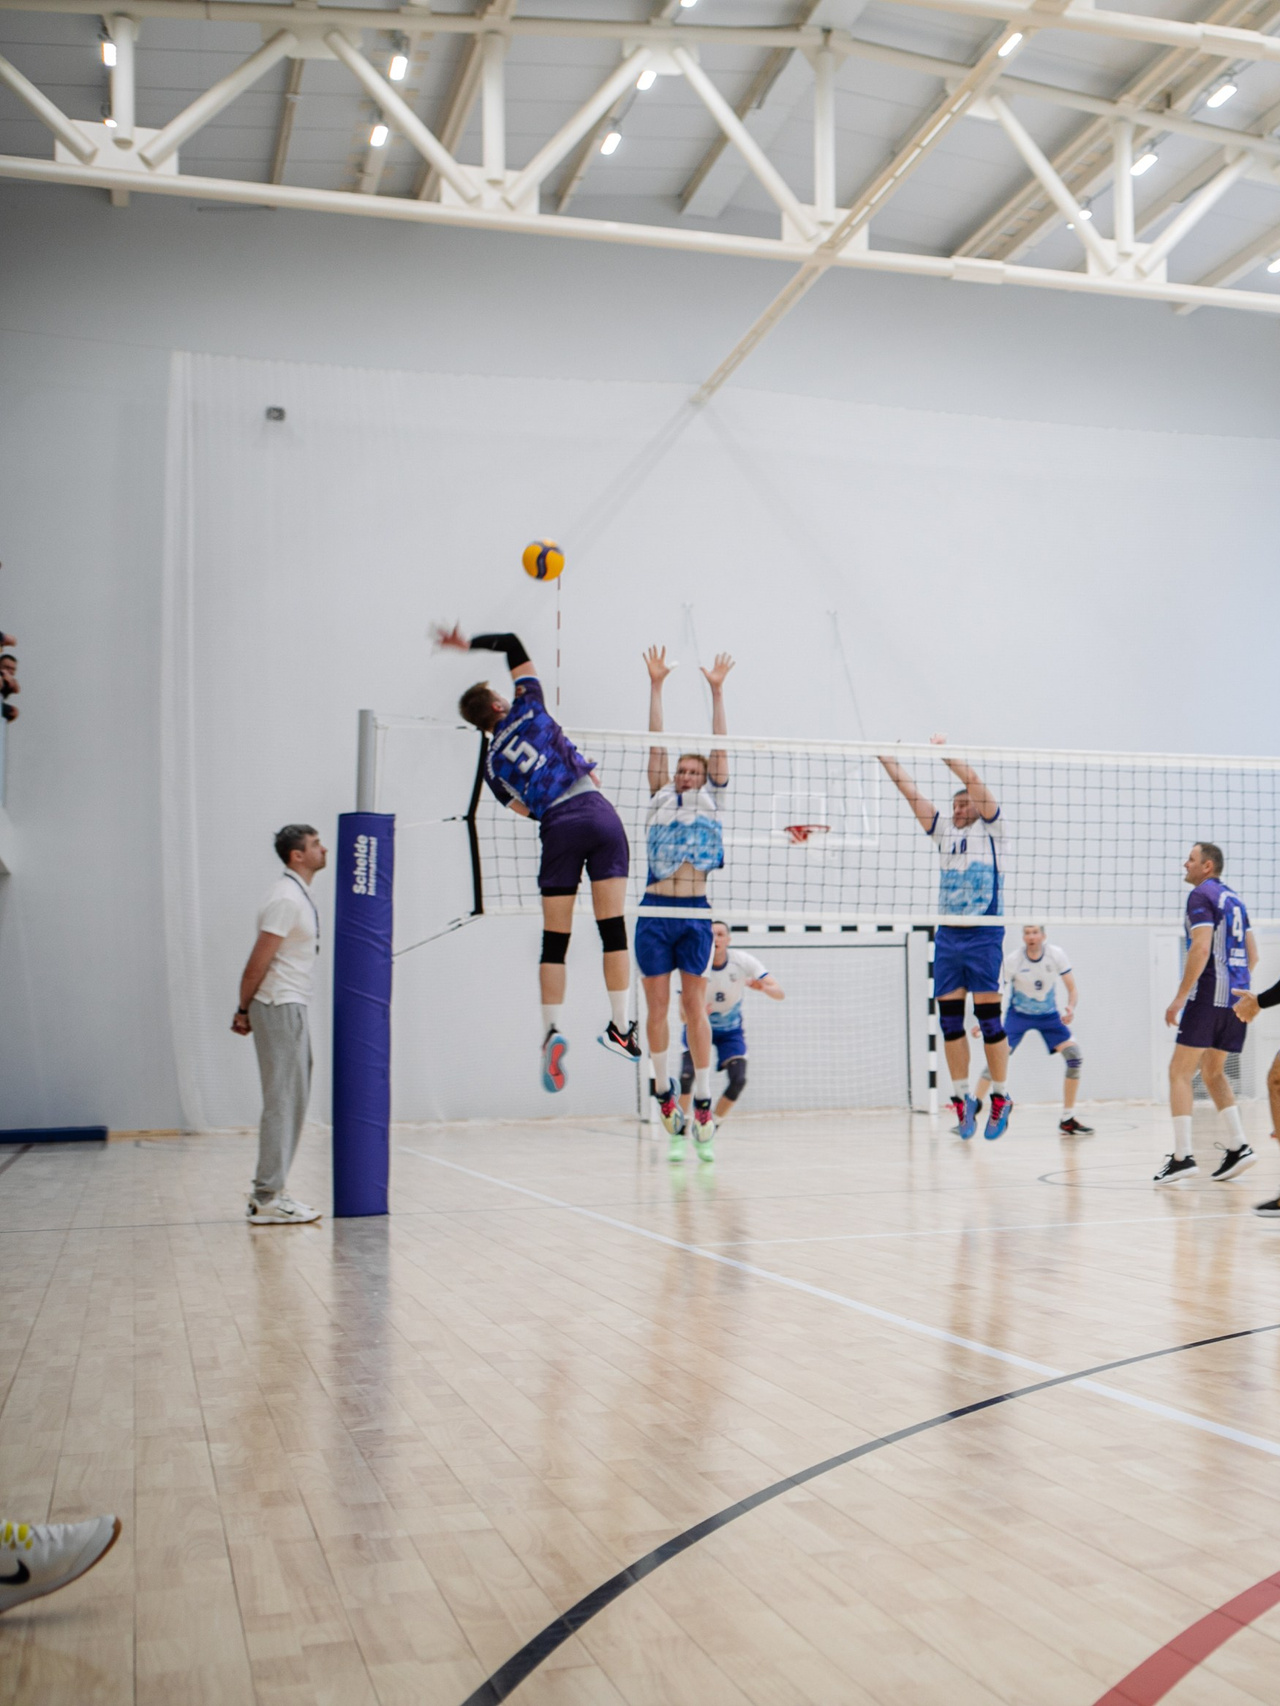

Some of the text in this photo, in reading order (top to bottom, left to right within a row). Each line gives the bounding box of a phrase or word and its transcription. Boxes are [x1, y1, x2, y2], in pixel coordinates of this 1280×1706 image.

[502, 735, 539, 774] 5
[1232, 906, 1244, 942] 4
[715, 992, 725, 1002] 8
[1034, 980, 1043, 991] 9
